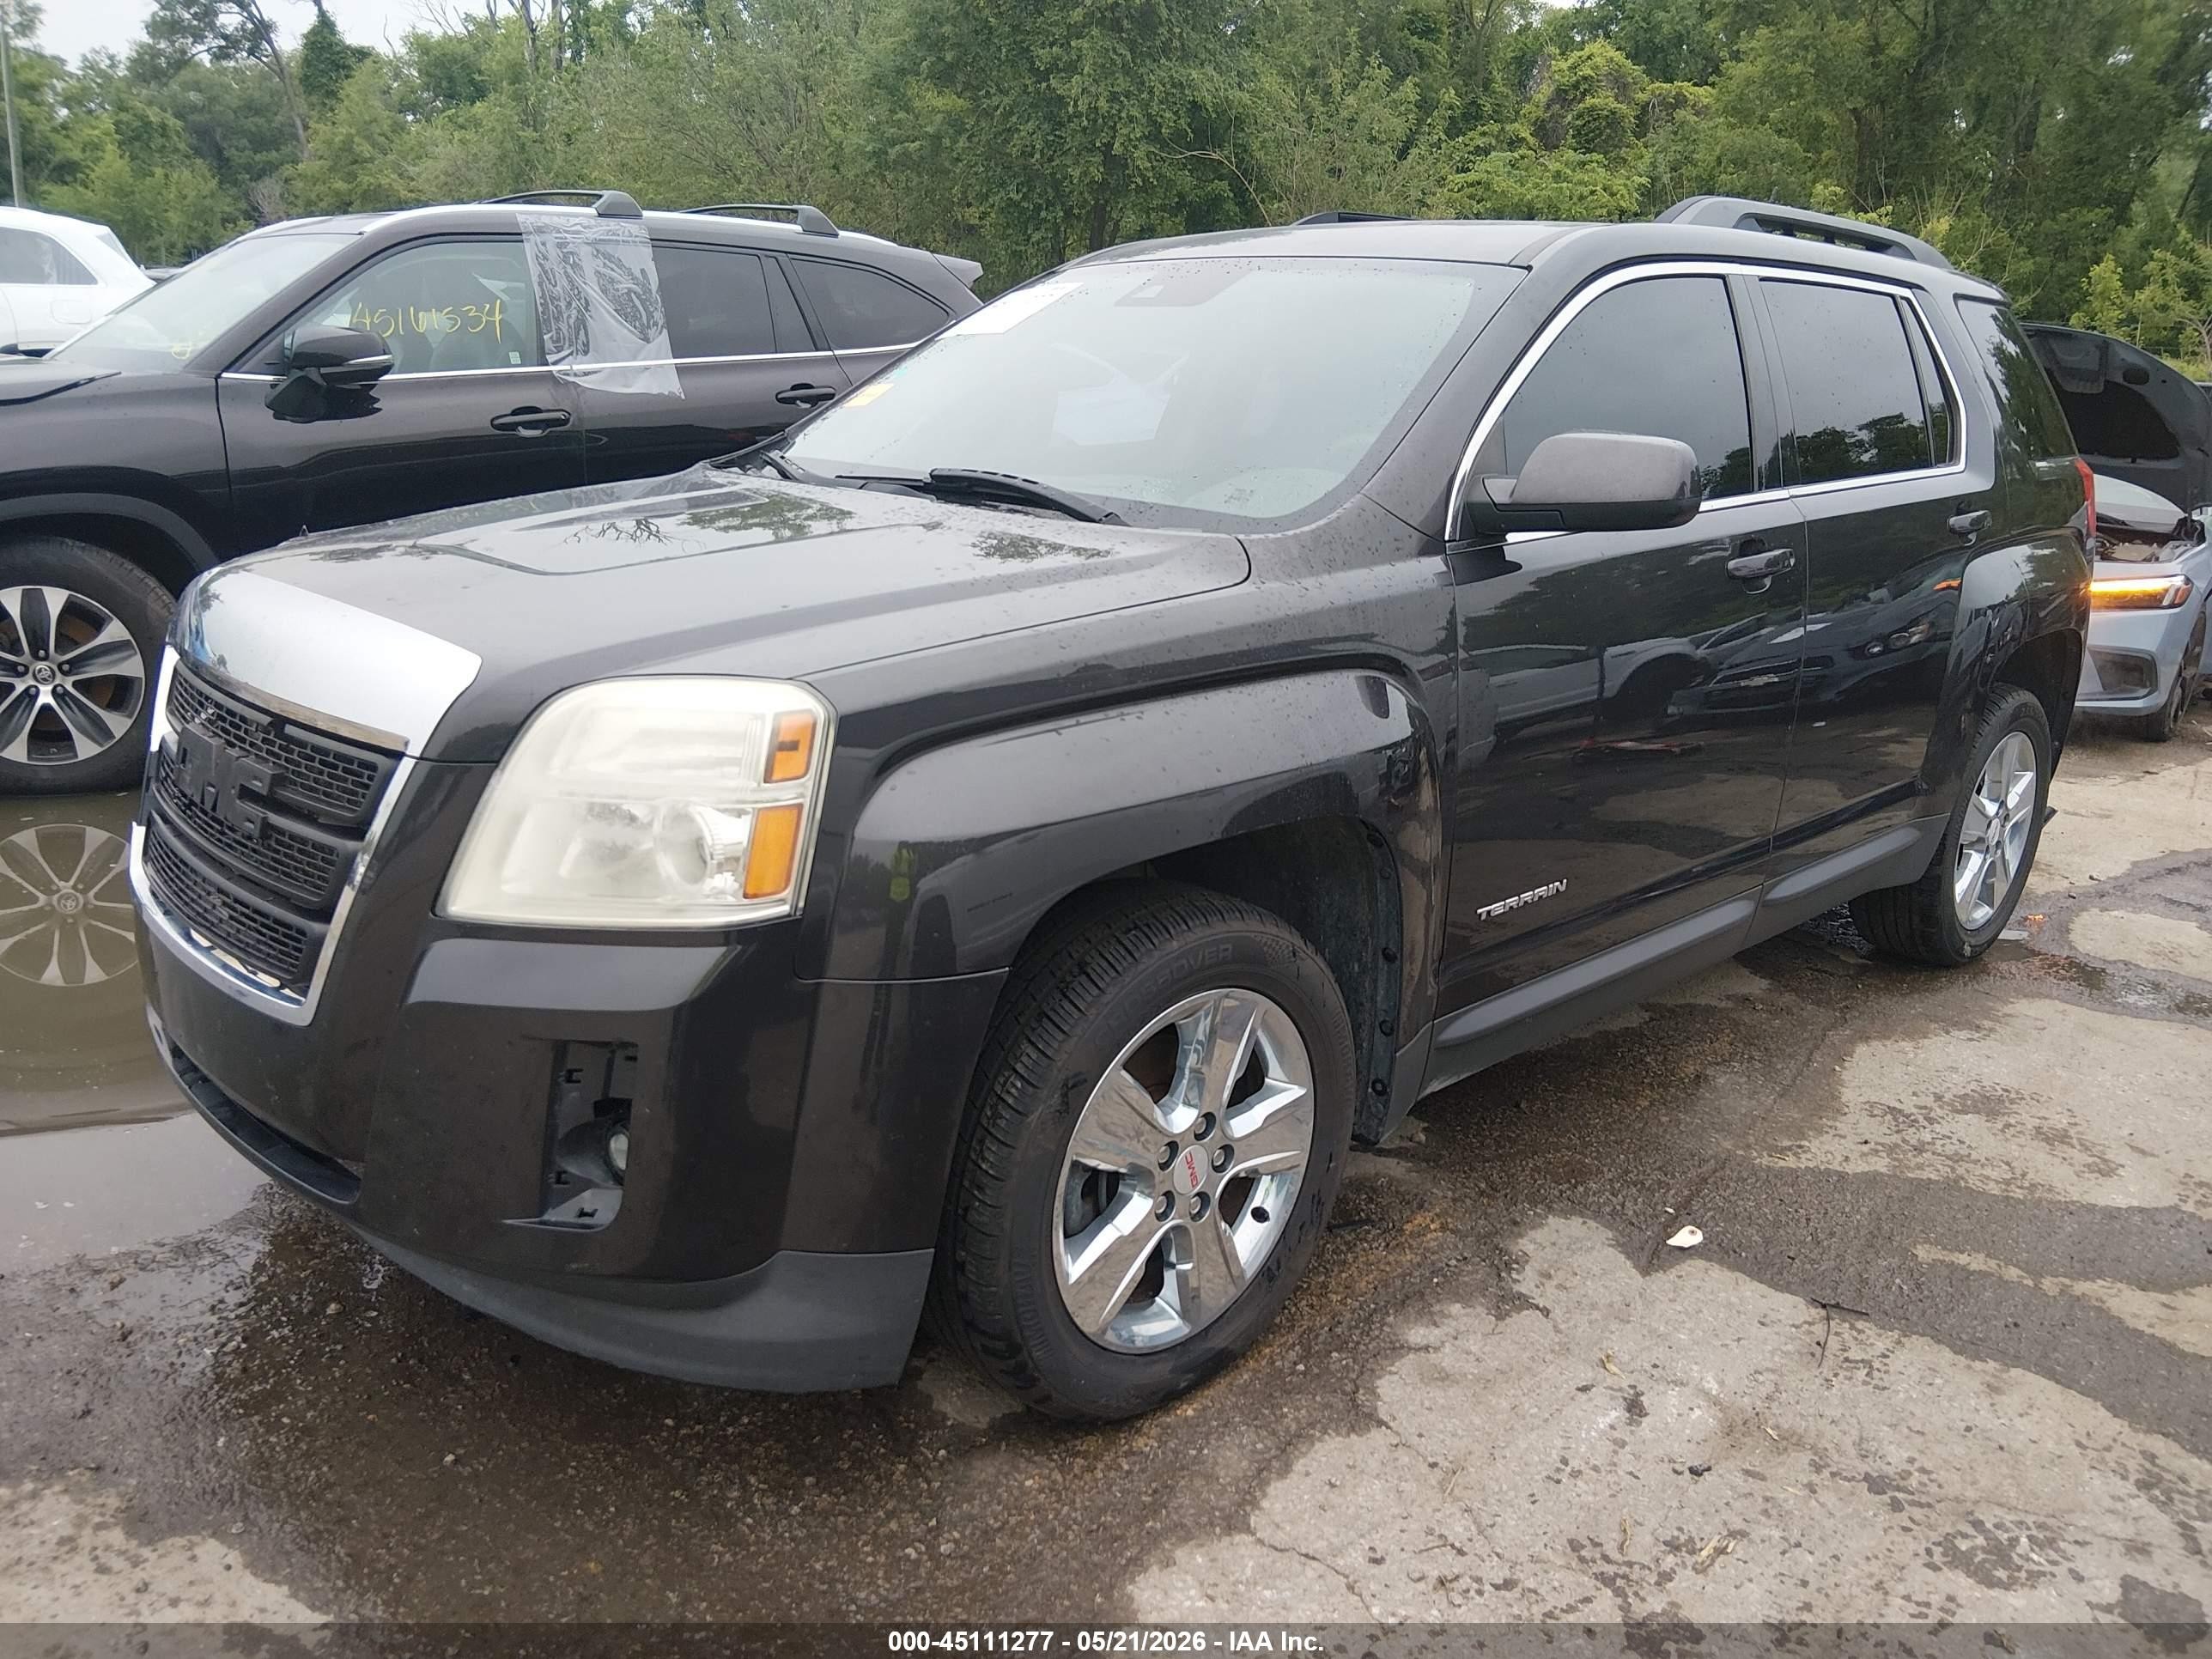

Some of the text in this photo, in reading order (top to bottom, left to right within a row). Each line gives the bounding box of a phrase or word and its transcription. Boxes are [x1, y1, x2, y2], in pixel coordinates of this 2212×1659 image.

[352, 299, 502, 344] 45161534
[1476, 878, 1567, 921] TERRAIN
[1184, 1150, 1200, 1189] GMC
